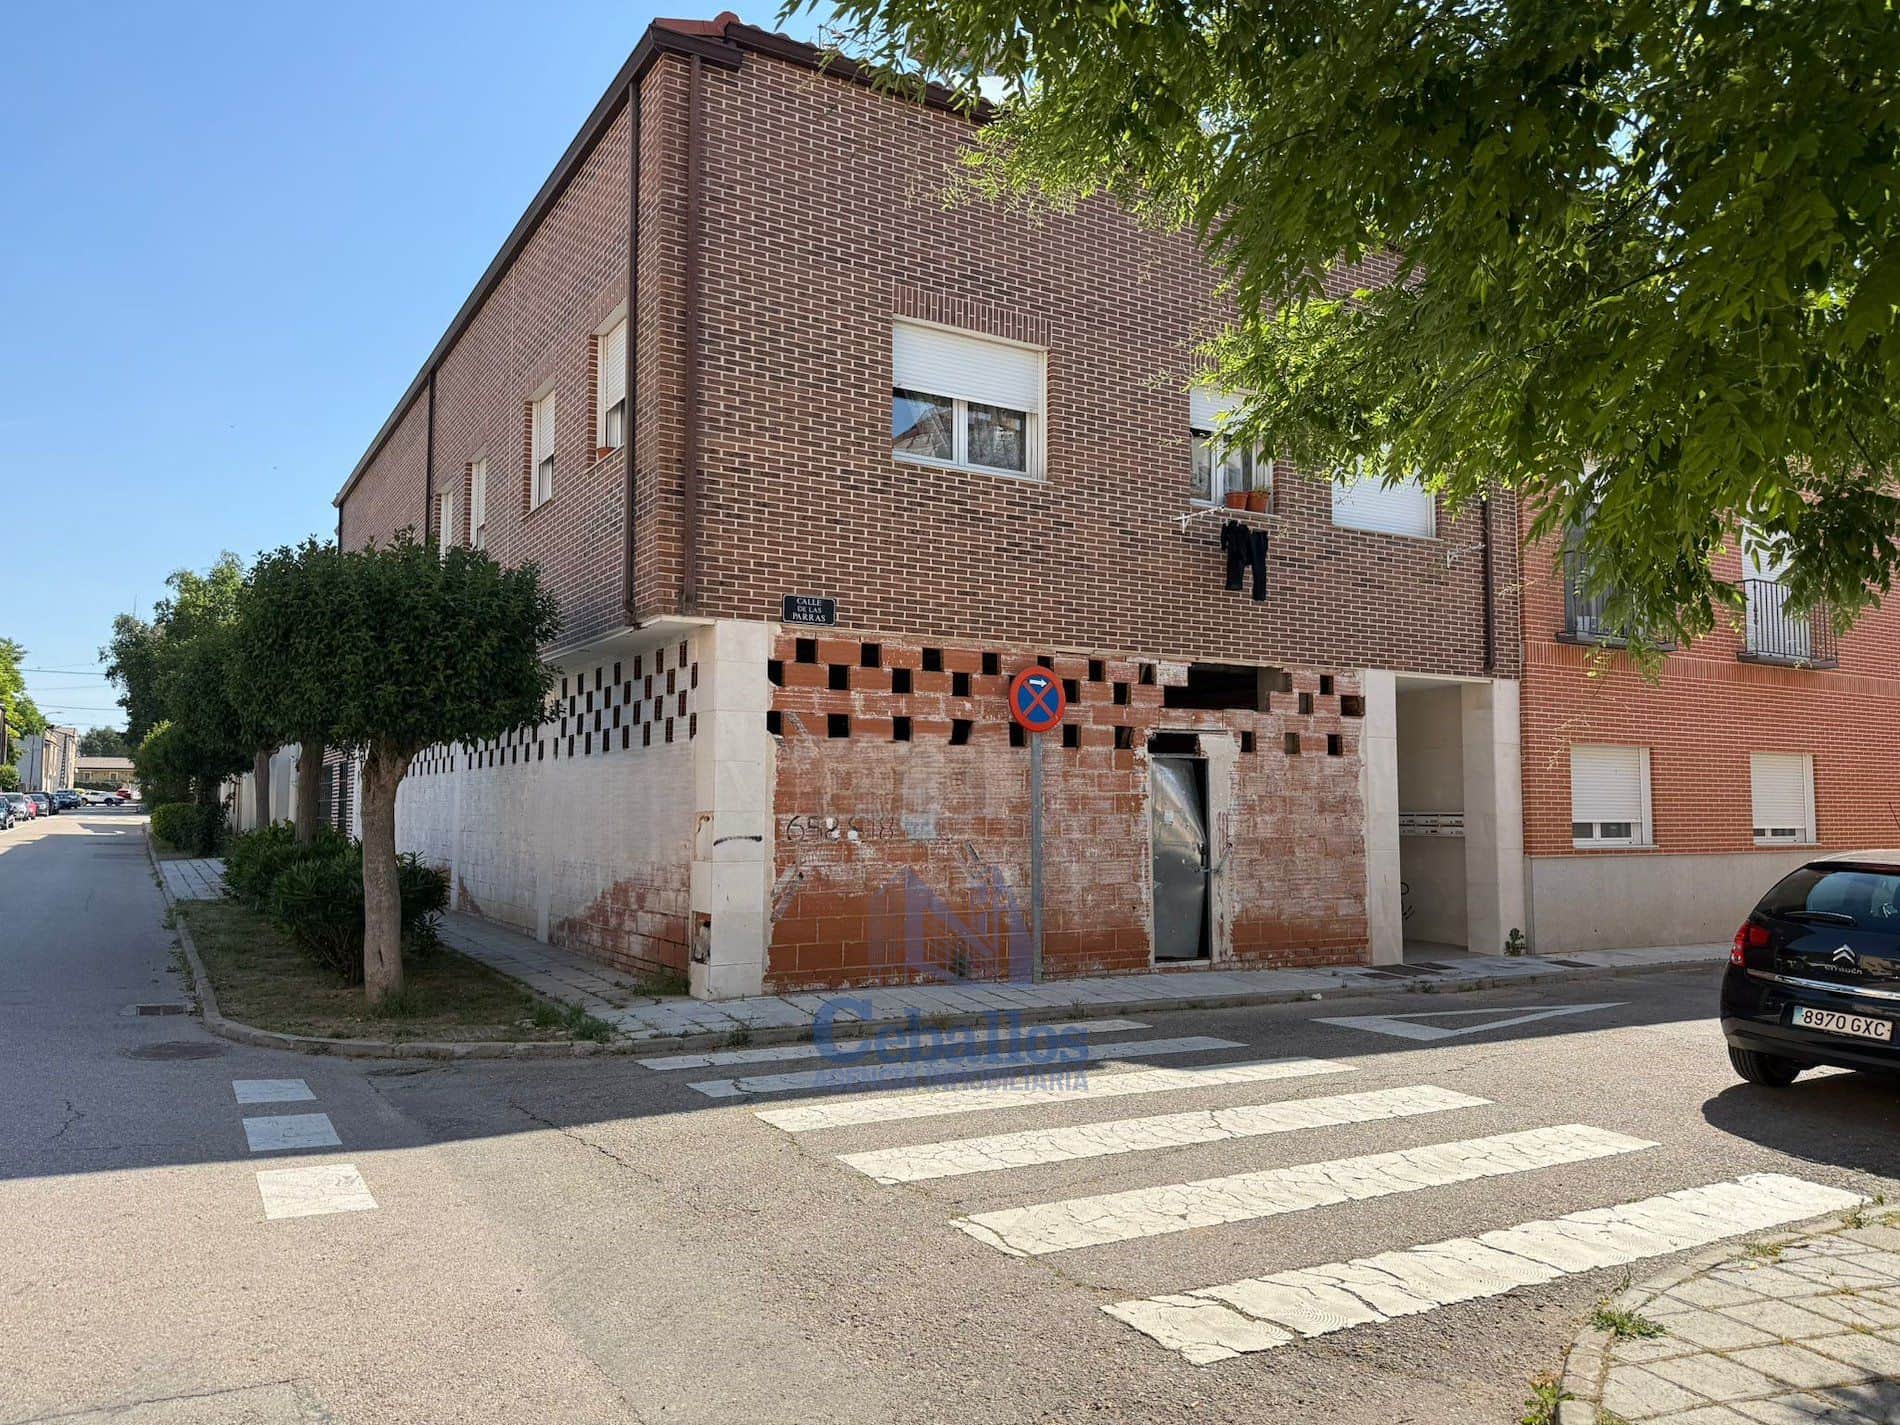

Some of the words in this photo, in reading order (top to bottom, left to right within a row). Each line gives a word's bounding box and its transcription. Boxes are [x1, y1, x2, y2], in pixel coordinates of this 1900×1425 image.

[796, 598, 822, 606] CALLE
[792, 612, 826, 622] PARRAS
[1803, 1010, 1846, 1029] 8970
[1850, 1017, 1886, 1037] GXC
